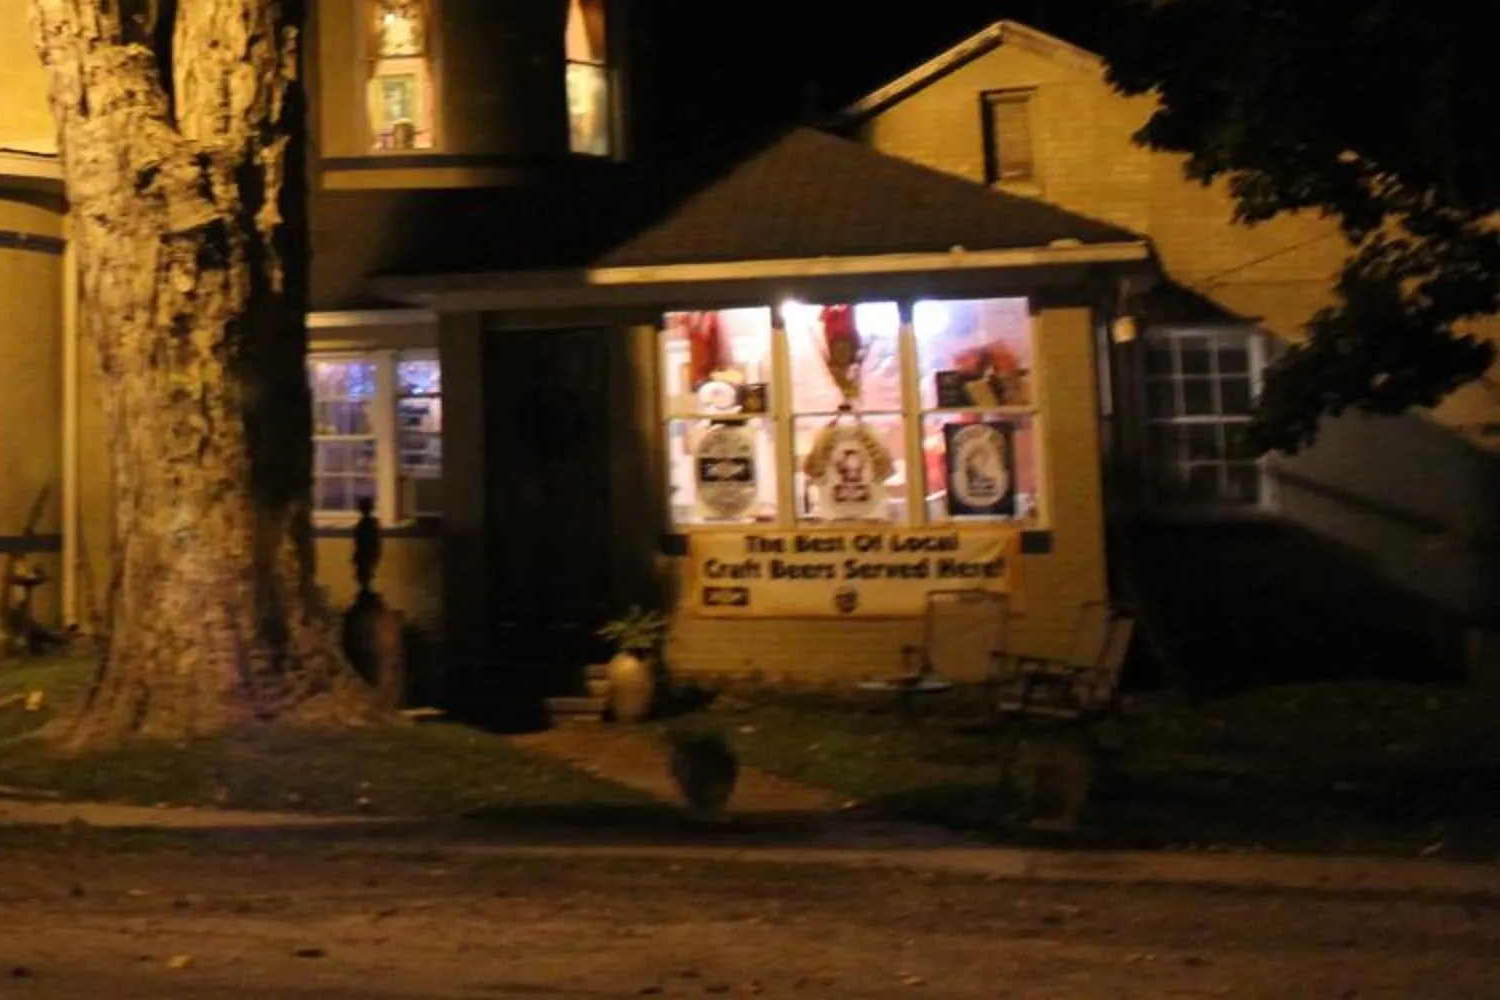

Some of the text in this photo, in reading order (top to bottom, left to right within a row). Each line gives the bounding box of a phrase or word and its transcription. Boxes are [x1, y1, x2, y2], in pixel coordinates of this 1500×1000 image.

[745, 533, 959, 553] The Best Of Local
[704, 558, 761, 580] Craft
[770, 559, 836, 580] Beers
[844, 558, 930, 580] Served
